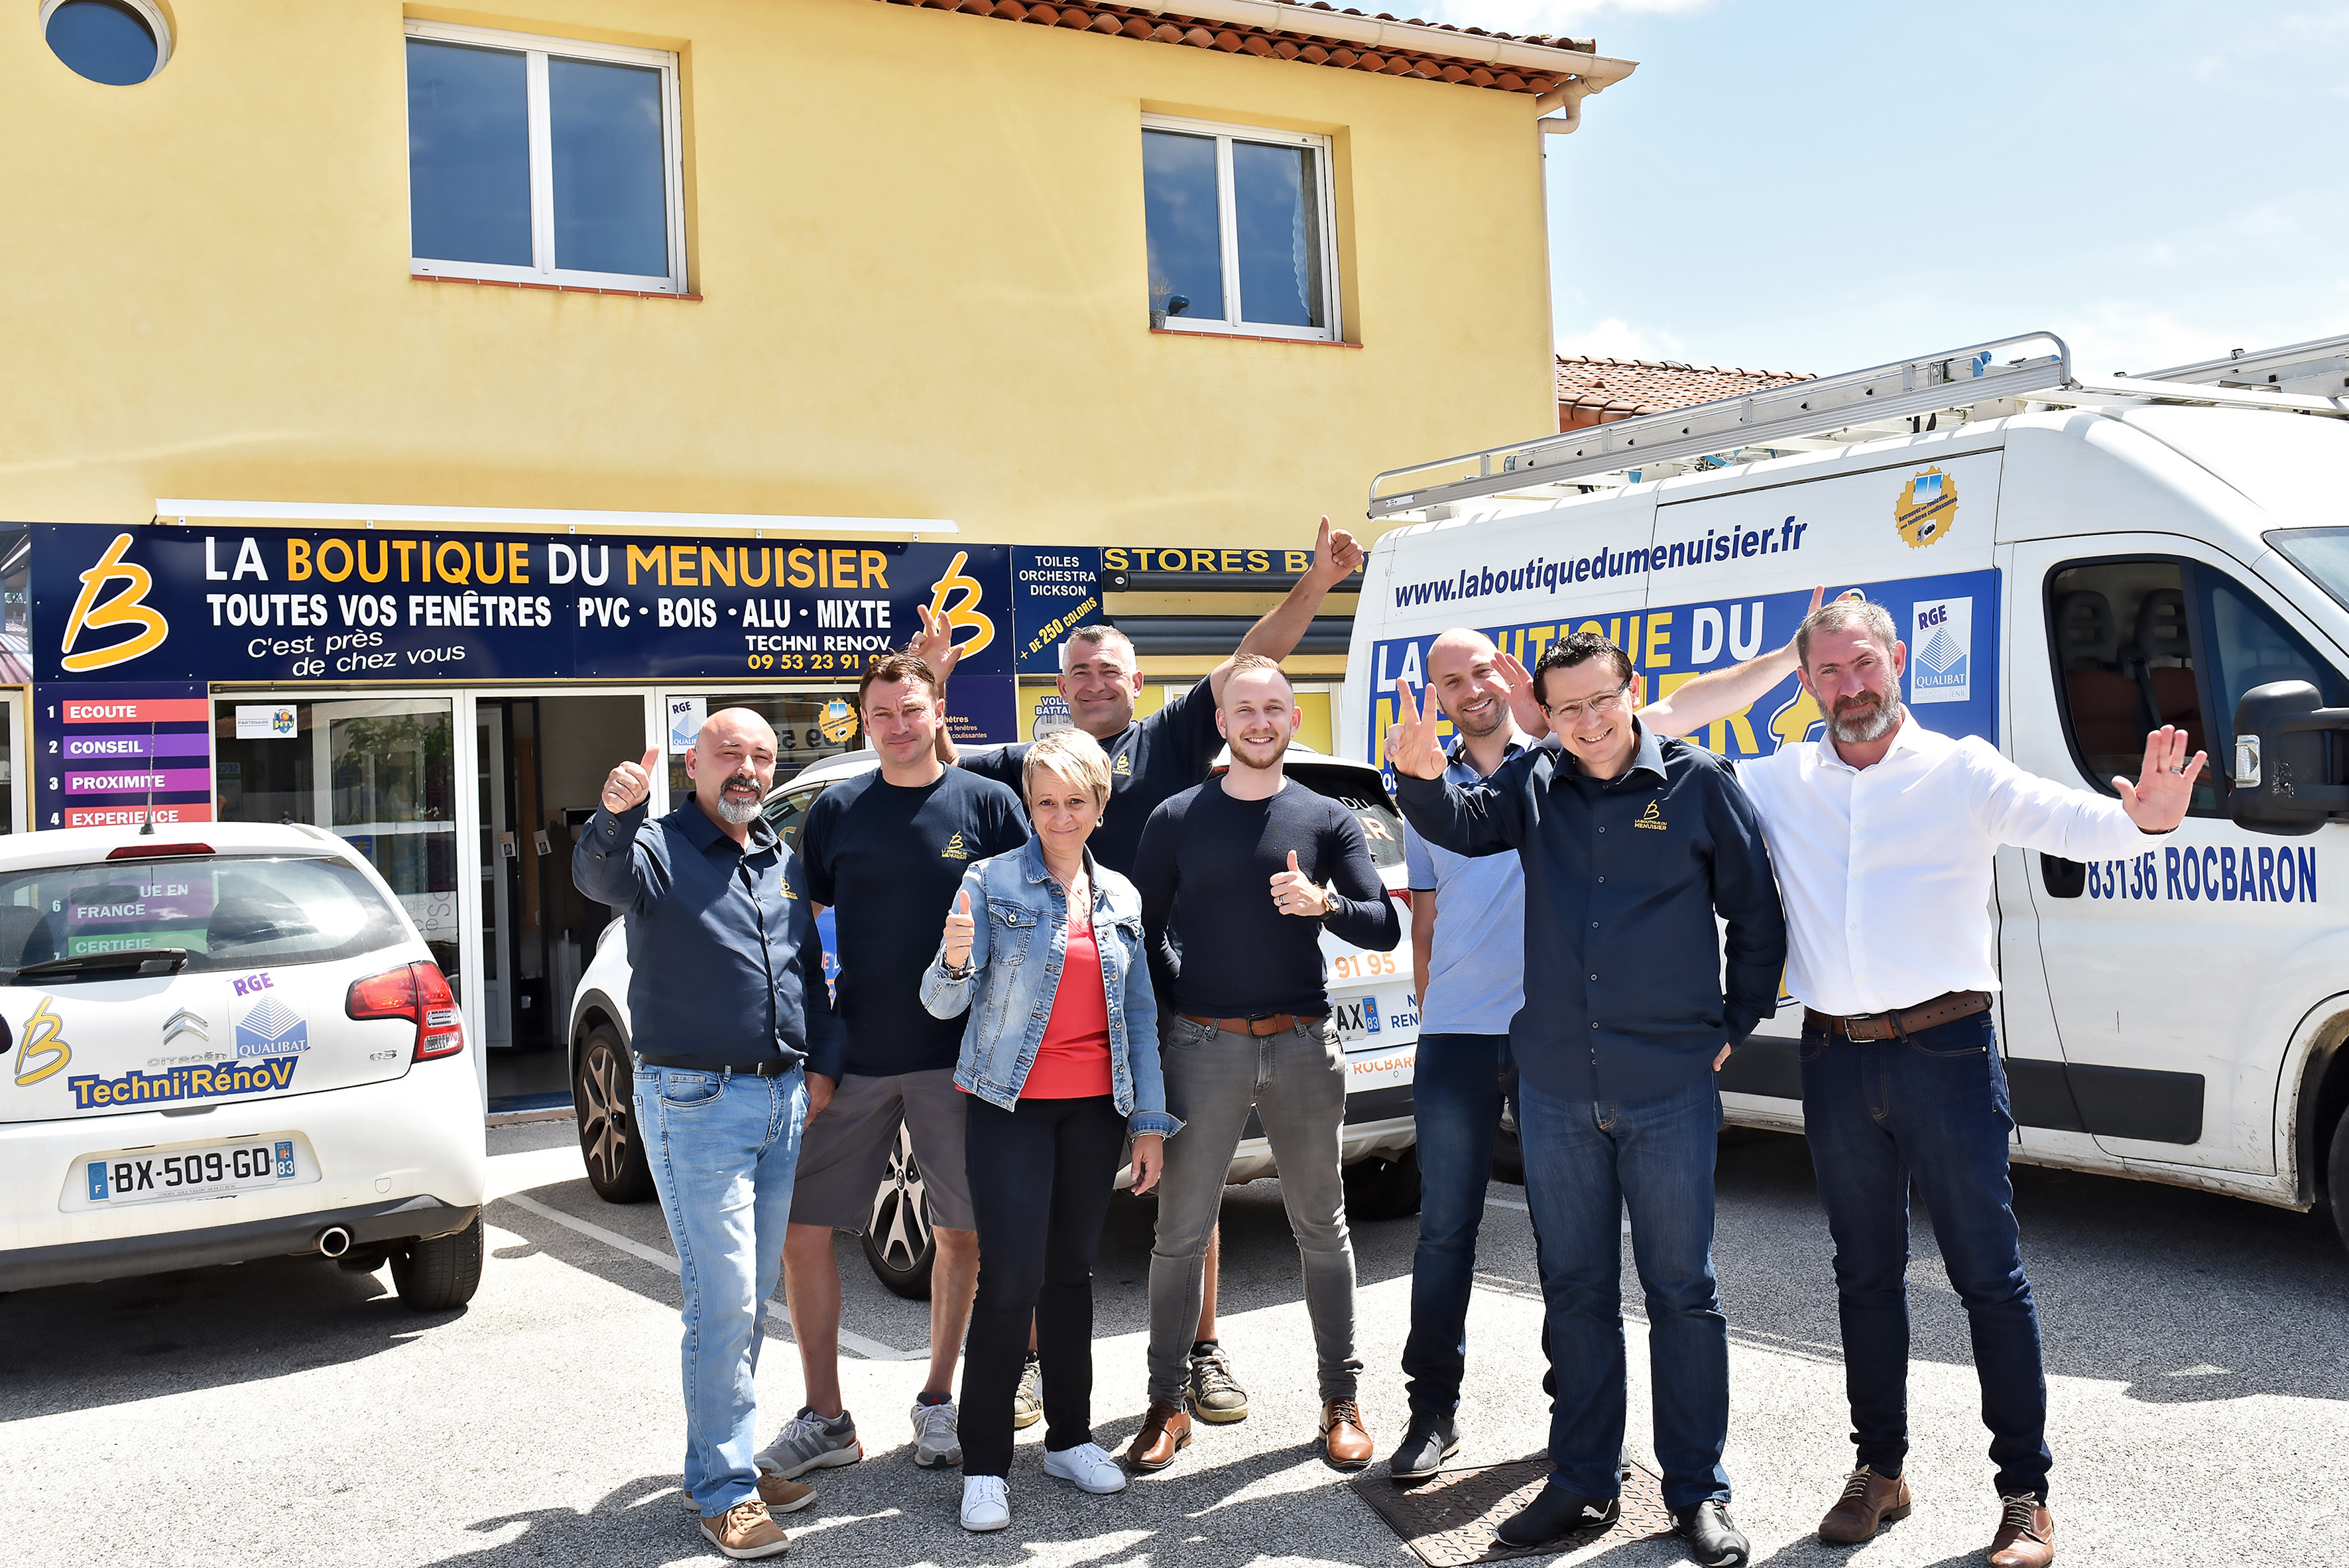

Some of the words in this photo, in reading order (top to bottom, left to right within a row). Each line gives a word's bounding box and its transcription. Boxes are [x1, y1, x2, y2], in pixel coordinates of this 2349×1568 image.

[1927, 496, 1958, 516] coulissantes
[205, 536, 269, 581] LA
[287, 538, 530, 585] BOUTIQUE
[548, 543, 609, 586] DU
[627, 544, 890, 589] MENUISIER
[1035, 556, 1079, 568] TOILES
[1104, 548, 1270, 572] STORES
[1395, 516, 1808, 608] www.laboutiquedumenuisier.fr
[1018, 570, 1097, 582] ORCHESTRA
[1030, 584, 1087, 596] DICKSON
[206, 593, 328, 627] TOUTES
[337, 594, 398, 627] VOS
[408, 589, 552, 627] FENÊTRES
[579, 597, 631, 627] PVC
[658, 597, 717, 628] BOIS
[742, 598, 790, 629] ALU
[817, 599, 891, 629] MIXTE
[1918, 604, 1947, 630] RGE
[1028, 637, 1044, 654] DE
[1038, 618, 1064, 645] 250
[1062, 596, 1098, 627] COLORIS
[247, 635, 315, 658] C'est
[326, 629, 383, 655] près
[745, 634, 816, 652] TECHNI
[823, 635, 891, 652] RENOV
[1376, 641, 1423, 693] LA
[1691, 601, 1764, 665] DU
[292, 657, 326, 676] de
[336, 652, 397, 672] chez
[406, 645, 466, 665] vous
[747, 654, 772, 670] 09
[780, 654, 804, 670] 53
[810, 654, 834, 670] 23
[839, 654, 859, 670] 91
[1916, 673, 1965, 688] QUALIBAT
[47, 705, 54, 718] 1
[70, 705, 137, 719] ECOUTE
[672, 701, 692, 714] RGE
[48, 740, 58, 754] 2
[70, 741, 143, 754] CONSEIL
[49, 777, 59, 790] 3
[72, 774, 165, 790] PROXIMITE
[1339, 796, 1372, 812] DU
[50, 812, 60, 825] 4
[72, 810, 179, 825] EXPERIENCE
[2088, 851, 2157, 900] 83136
[2165, 845, 2317, 902] ROCBARON
[52, 900, 61, 912] 6
[167, 884, 188, 896] EN
[77, 904, 145, 919] FRANCE
[1335, 955, 1360, 979] 91
[1366, 953, 1396, 975] 95
[233, 972, 274, 996] RGE
[1366, 1016, 1378, 1030] 83
[239, 1039, 306, 1057] QUALIBAT
[369, 1048, 398, 1061] C3
[115, 1147, 271, 1193] BX-509-GD
[277, 1160, 294, 1175] 83
[95, 1184, 101, 1194] F
